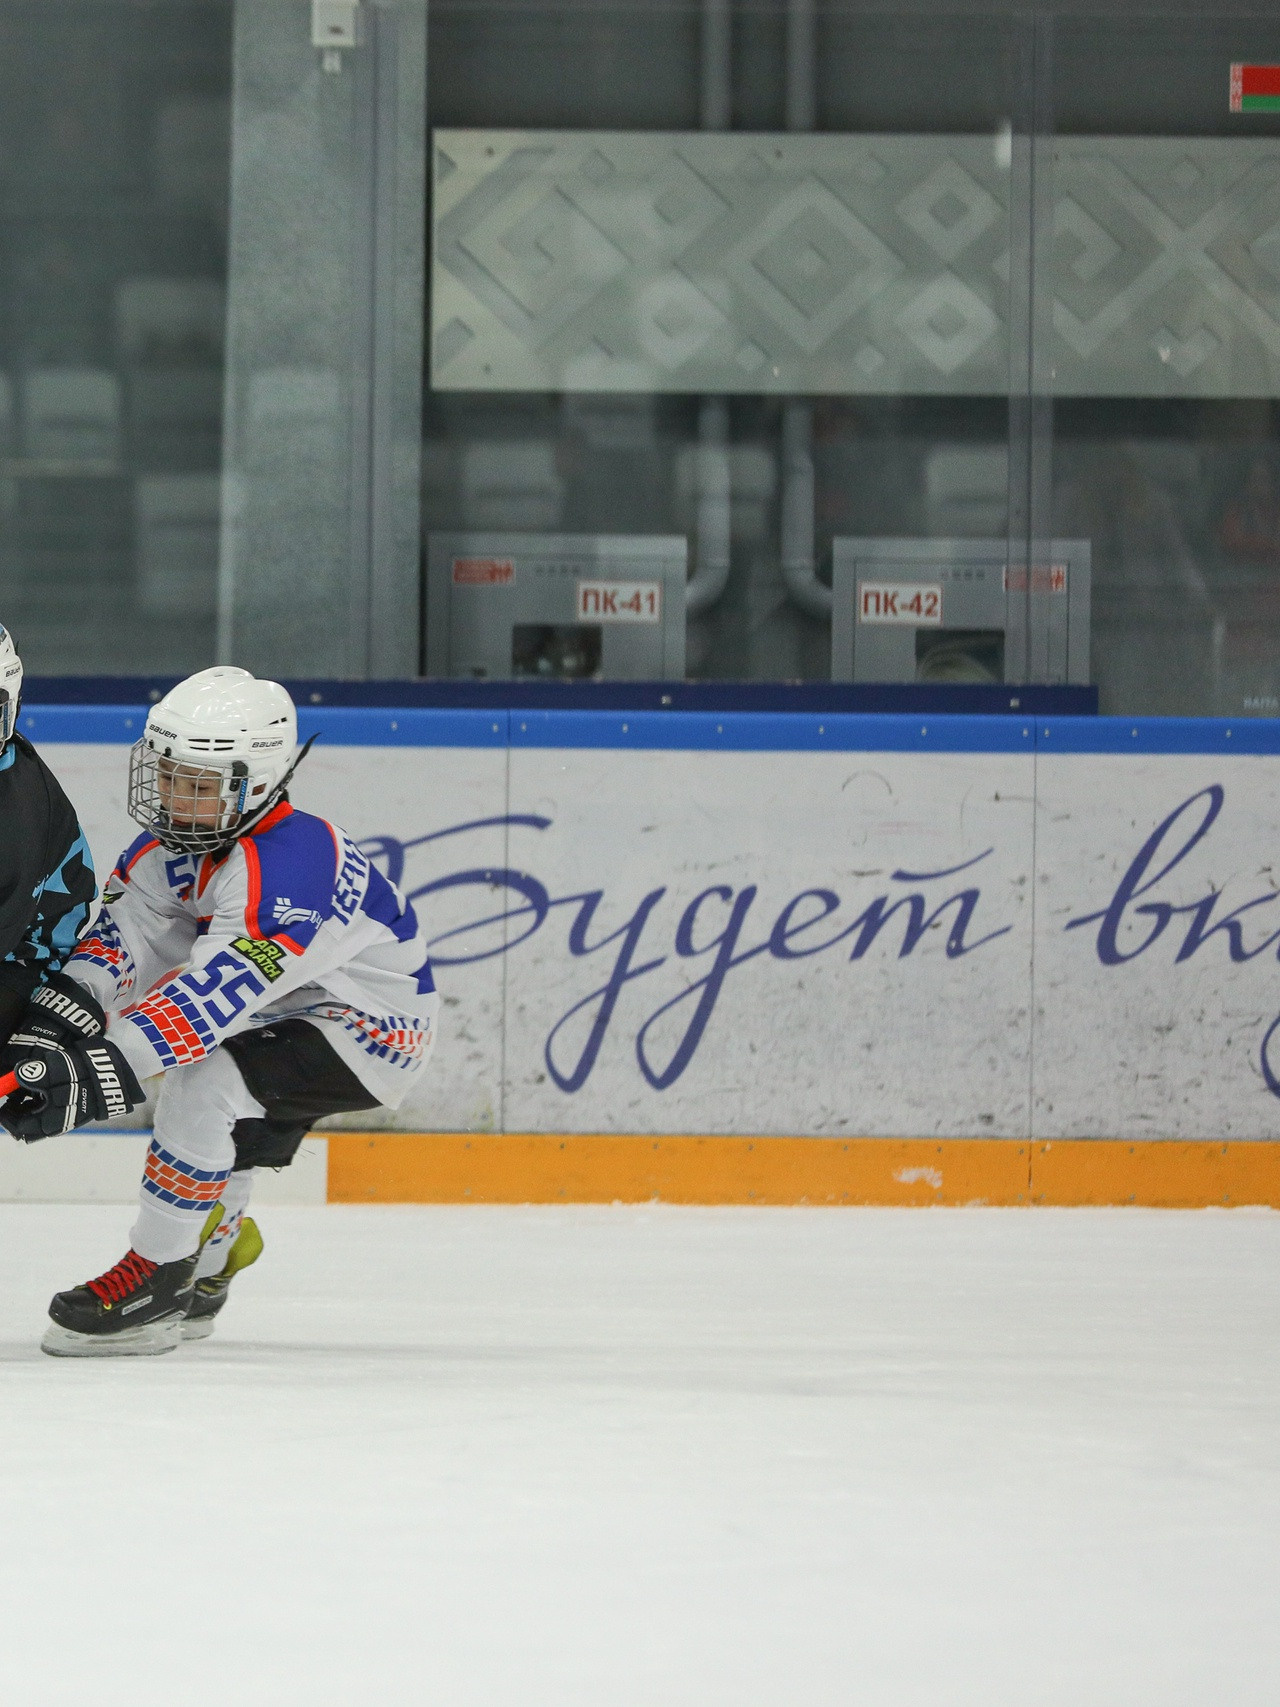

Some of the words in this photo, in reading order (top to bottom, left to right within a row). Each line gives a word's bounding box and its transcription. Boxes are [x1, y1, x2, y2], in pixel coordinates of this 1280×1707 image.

[582, 588, 656, 614] ПК-41
[863, 590, 939, 617] ПК-42
[149, 723, 178, 740] BAUER
[251, 740, 284, 748] BAUER
[1063, 783, 1280, 1101] вк
[247, 948, 281, 979] MATCH
[178, 950, 266, 1029] 55
[32, 986, 102, 1038] RRIOR
[31, 1025, 58, 1037] COVERT
